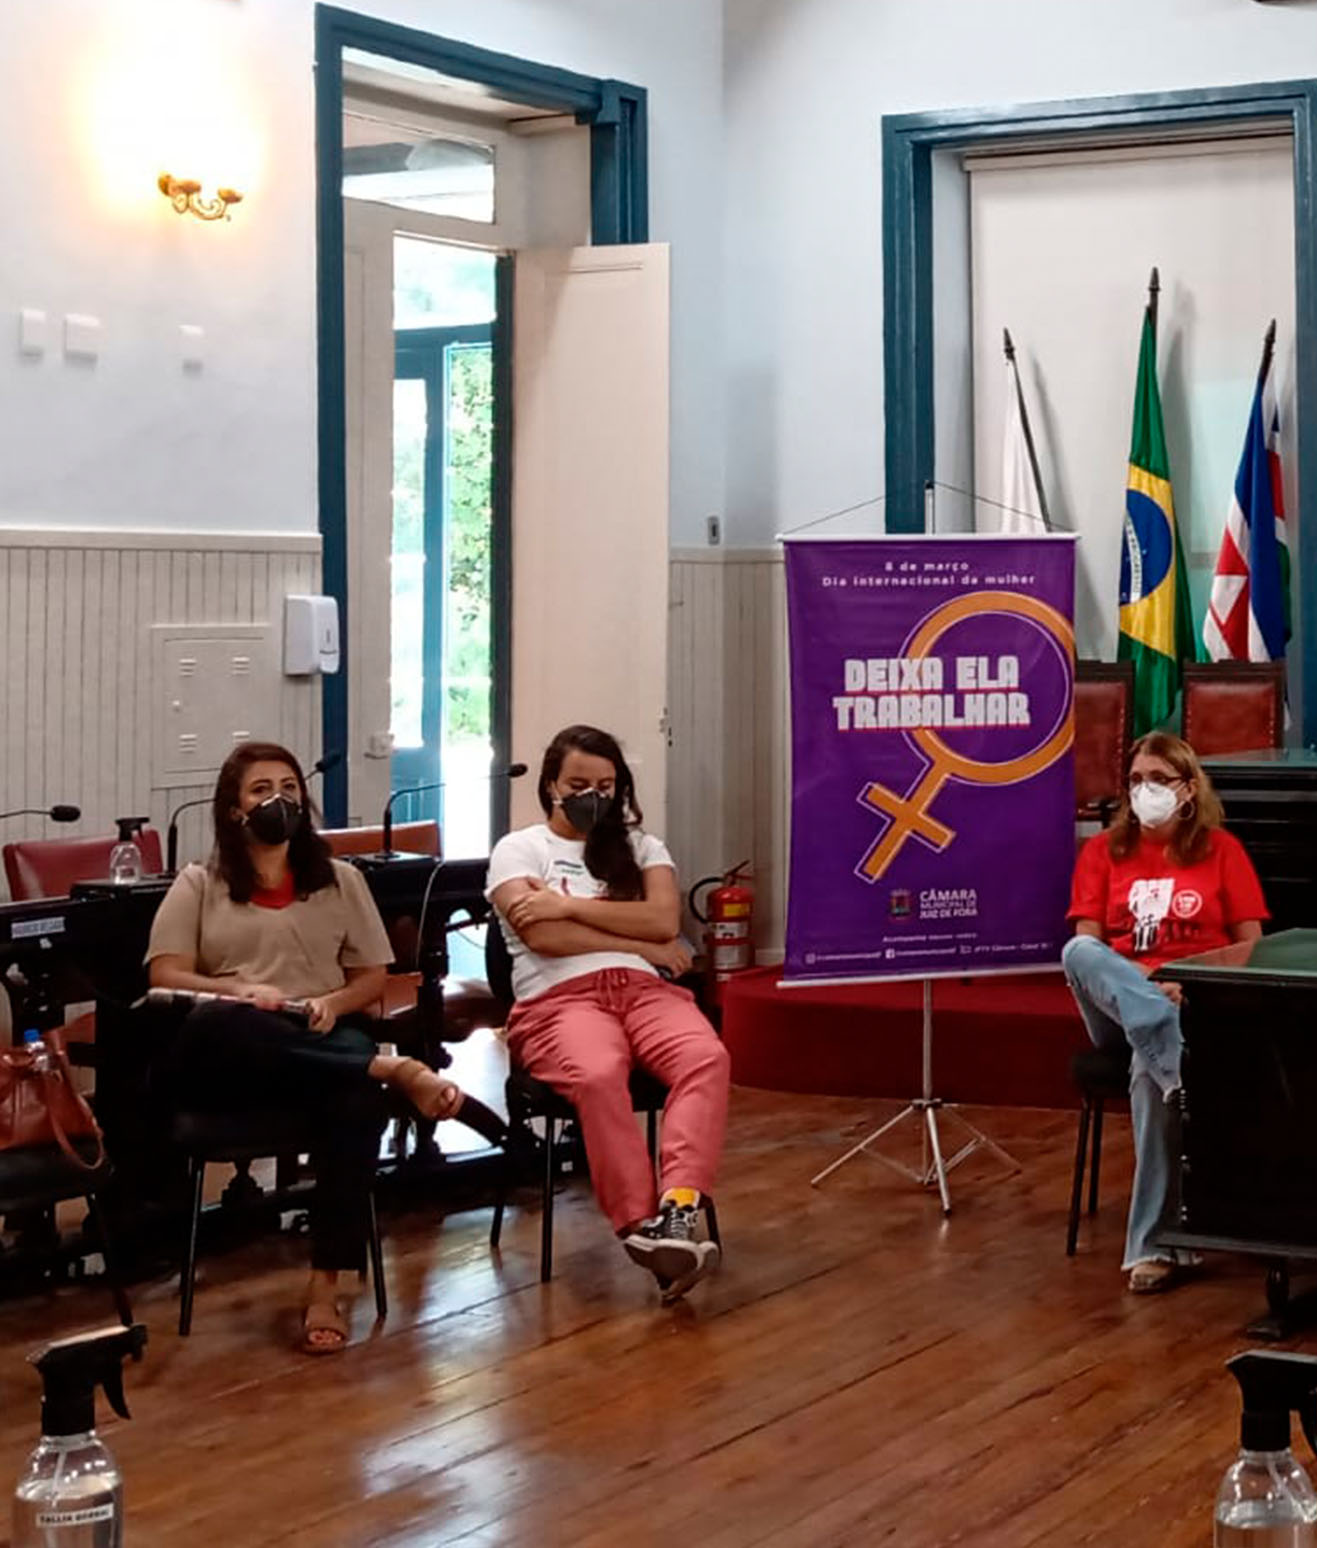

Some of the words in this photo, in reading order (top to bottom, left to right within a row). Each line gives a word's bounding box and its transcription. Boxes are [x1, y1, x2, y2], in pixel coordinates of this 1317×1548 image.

[885, 562, 893, 571] 8
[900, 561, 917, 571] de
[924, 562, 969, 572] março
[822, 576, 847, 587] Dia
[985, 573, 1035, 585] mulher
[844, 657, 943, 692] DEIXA
[956, 655, 1019, 690] ELA
[833, 692, 1031, 730] TRABALHAR
[919, 888, 978, 901] CÂMARA
[953, 907, 978, 917] FORA
